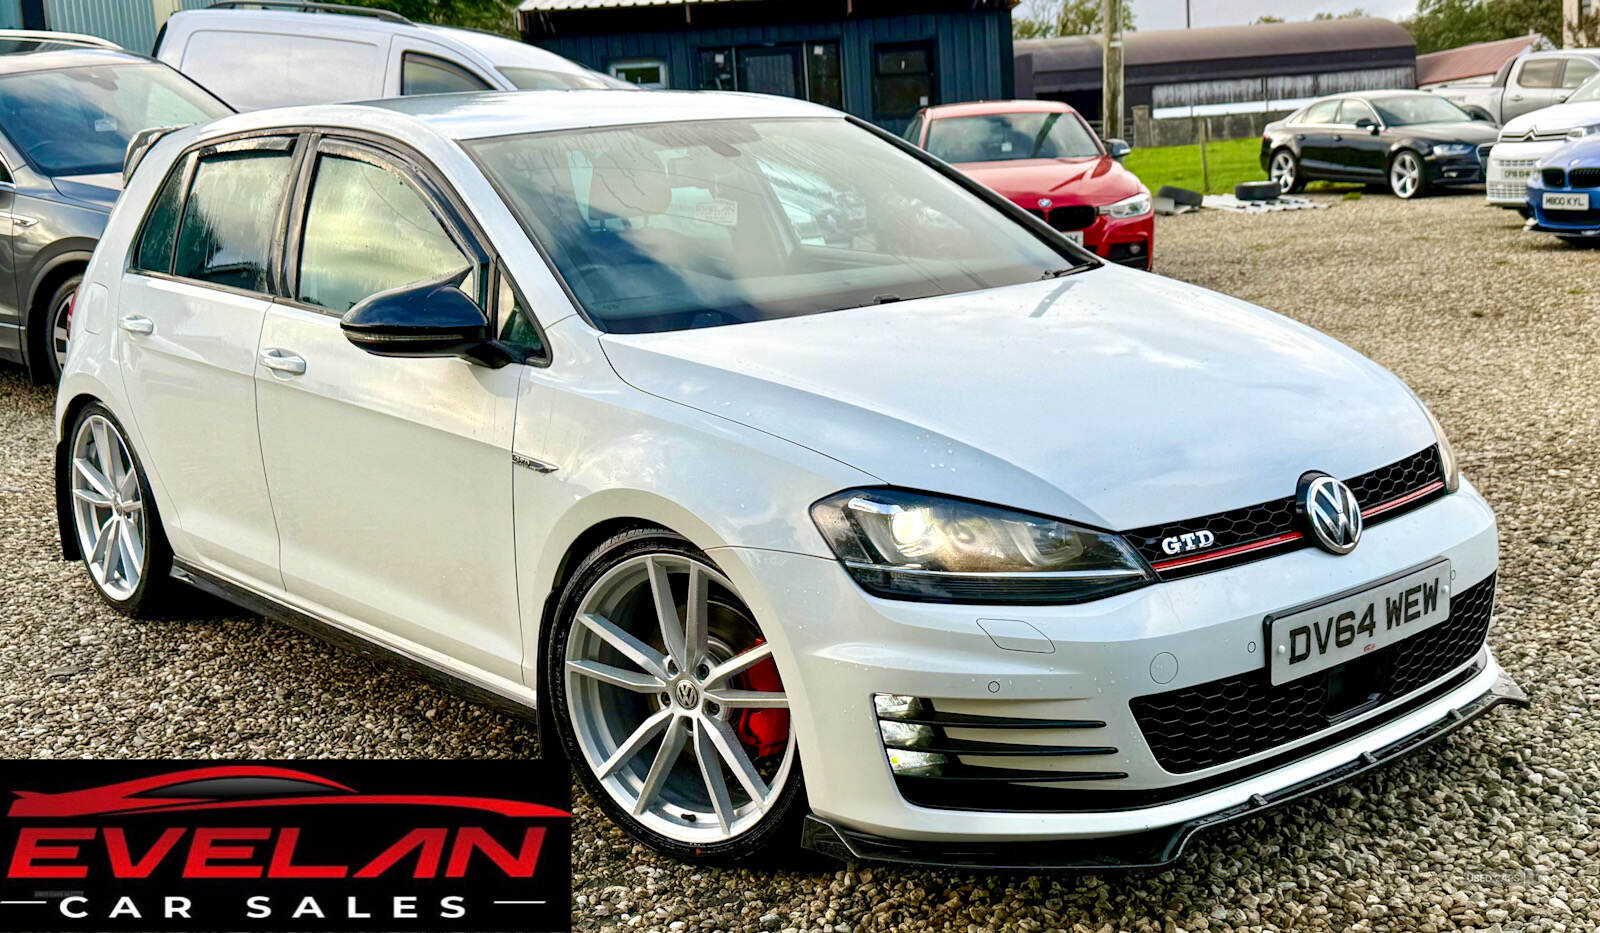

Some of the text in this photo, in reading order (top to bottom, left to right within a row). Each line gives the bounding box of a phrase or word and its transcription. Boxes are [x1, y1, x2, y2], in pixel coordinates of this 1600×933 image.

[1161, 529, 1214, 555] GTD
[1289, 577, 1439, 665] DV64 WEW
